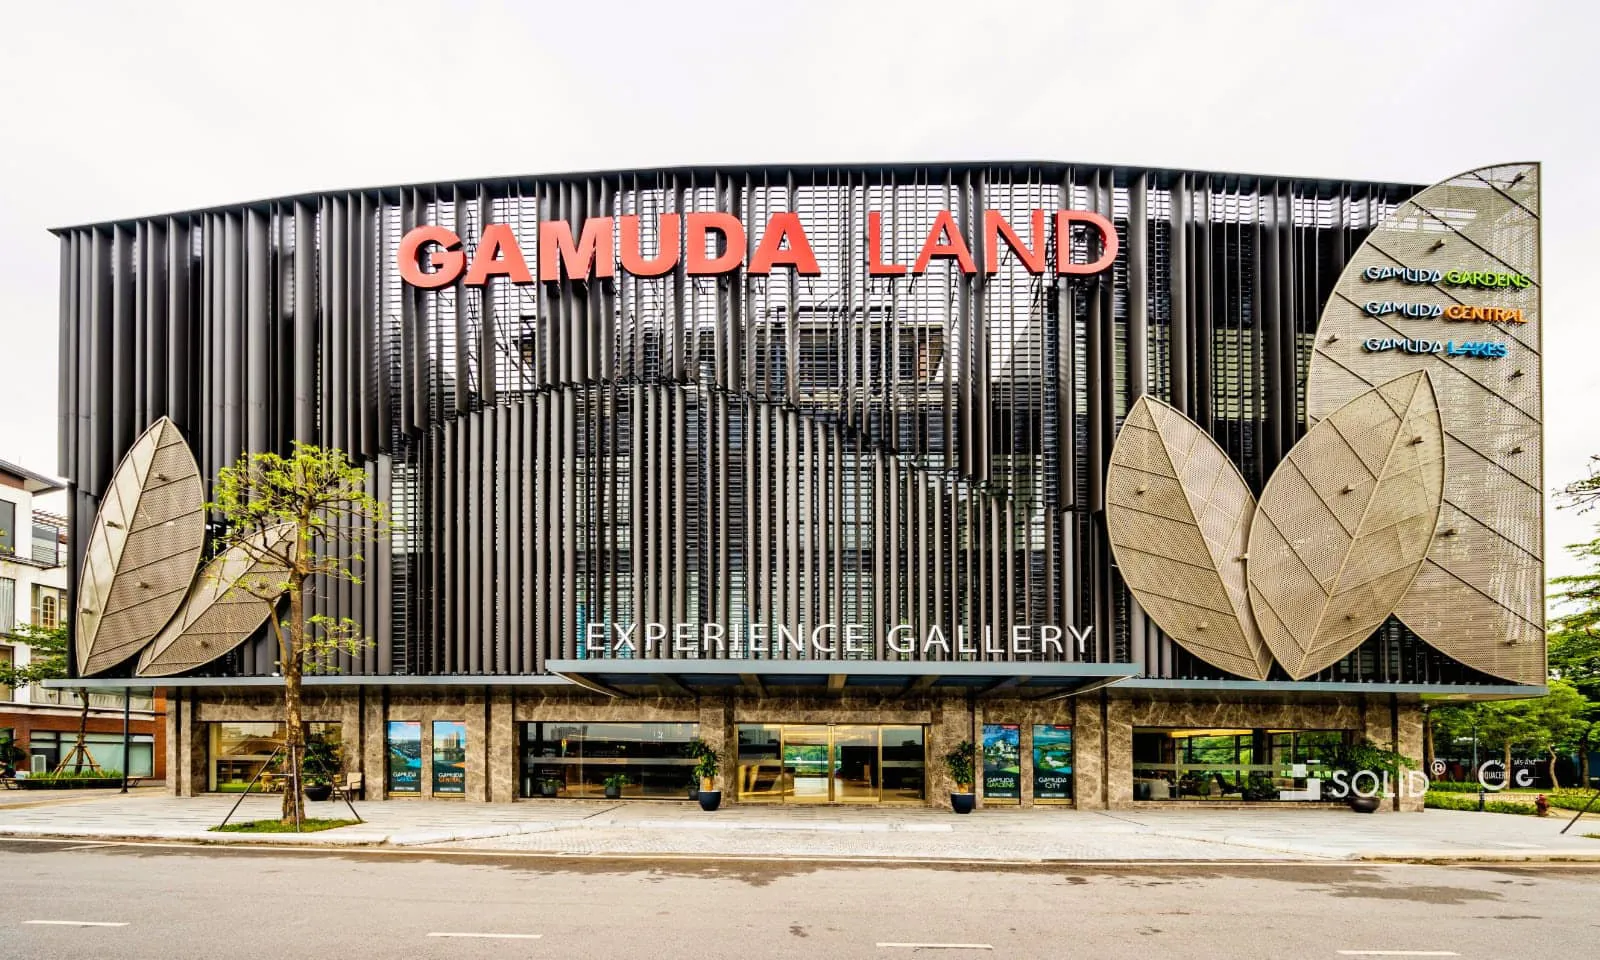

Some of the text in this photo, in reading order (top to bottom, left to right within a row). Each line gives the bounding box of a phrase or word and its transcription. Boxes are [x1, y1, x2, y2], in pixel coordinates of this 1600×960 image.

[397, 209, 1119, 290] GAMUDA LAND
[1364, 266, 1531, 288] GAMUDA GARDENS
[1364, 301, 1528, 323] GAMUDA CENTRAL
[1364, 337, 1509, 358] GAMUDA LAKES
[586, 622, 1094, 653] EXPERIENCE GALLERY
